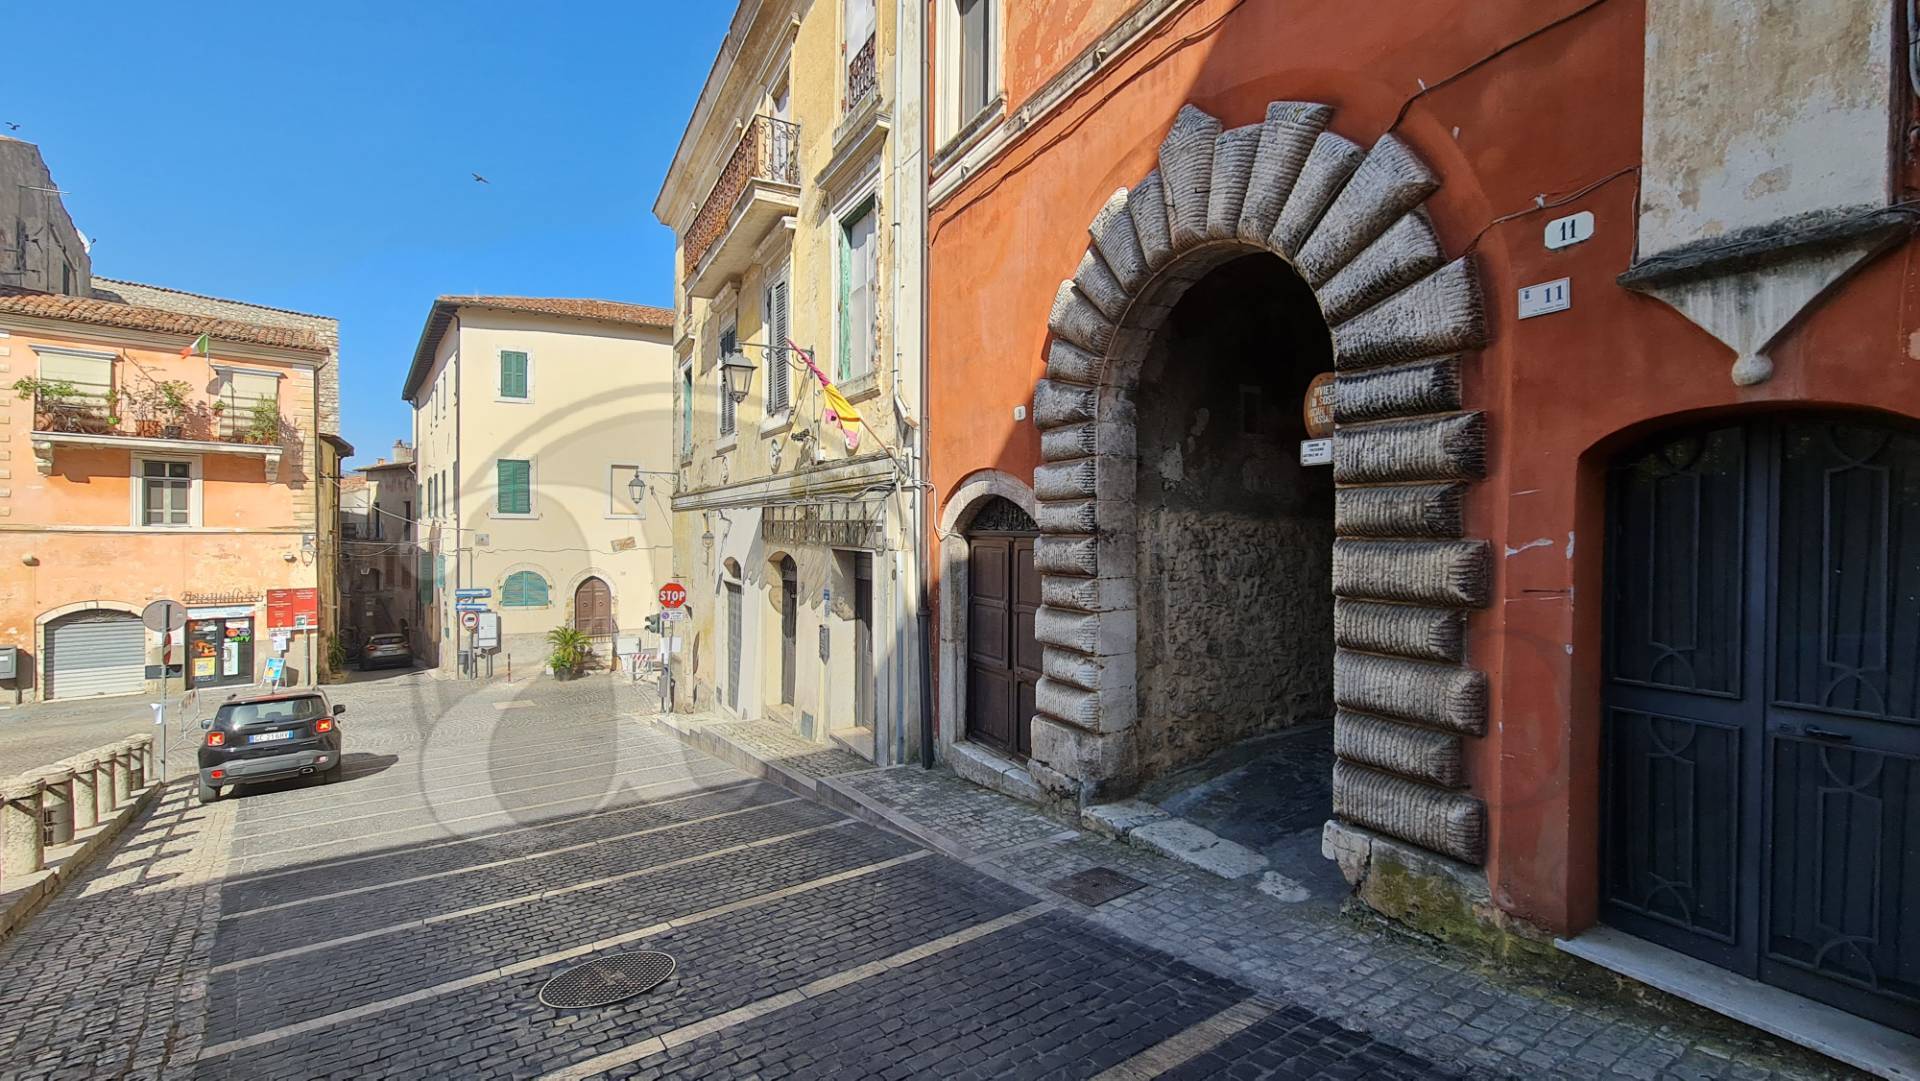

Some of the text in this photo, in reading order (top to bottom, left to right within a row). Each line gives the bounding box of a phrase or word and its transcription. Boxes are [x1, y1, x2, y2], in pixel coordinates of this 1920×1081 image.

[1560, 219, 1576, 241] 11
[1544, 284, 1562, 303] 11
[660, 590, 685, 603] STOP
